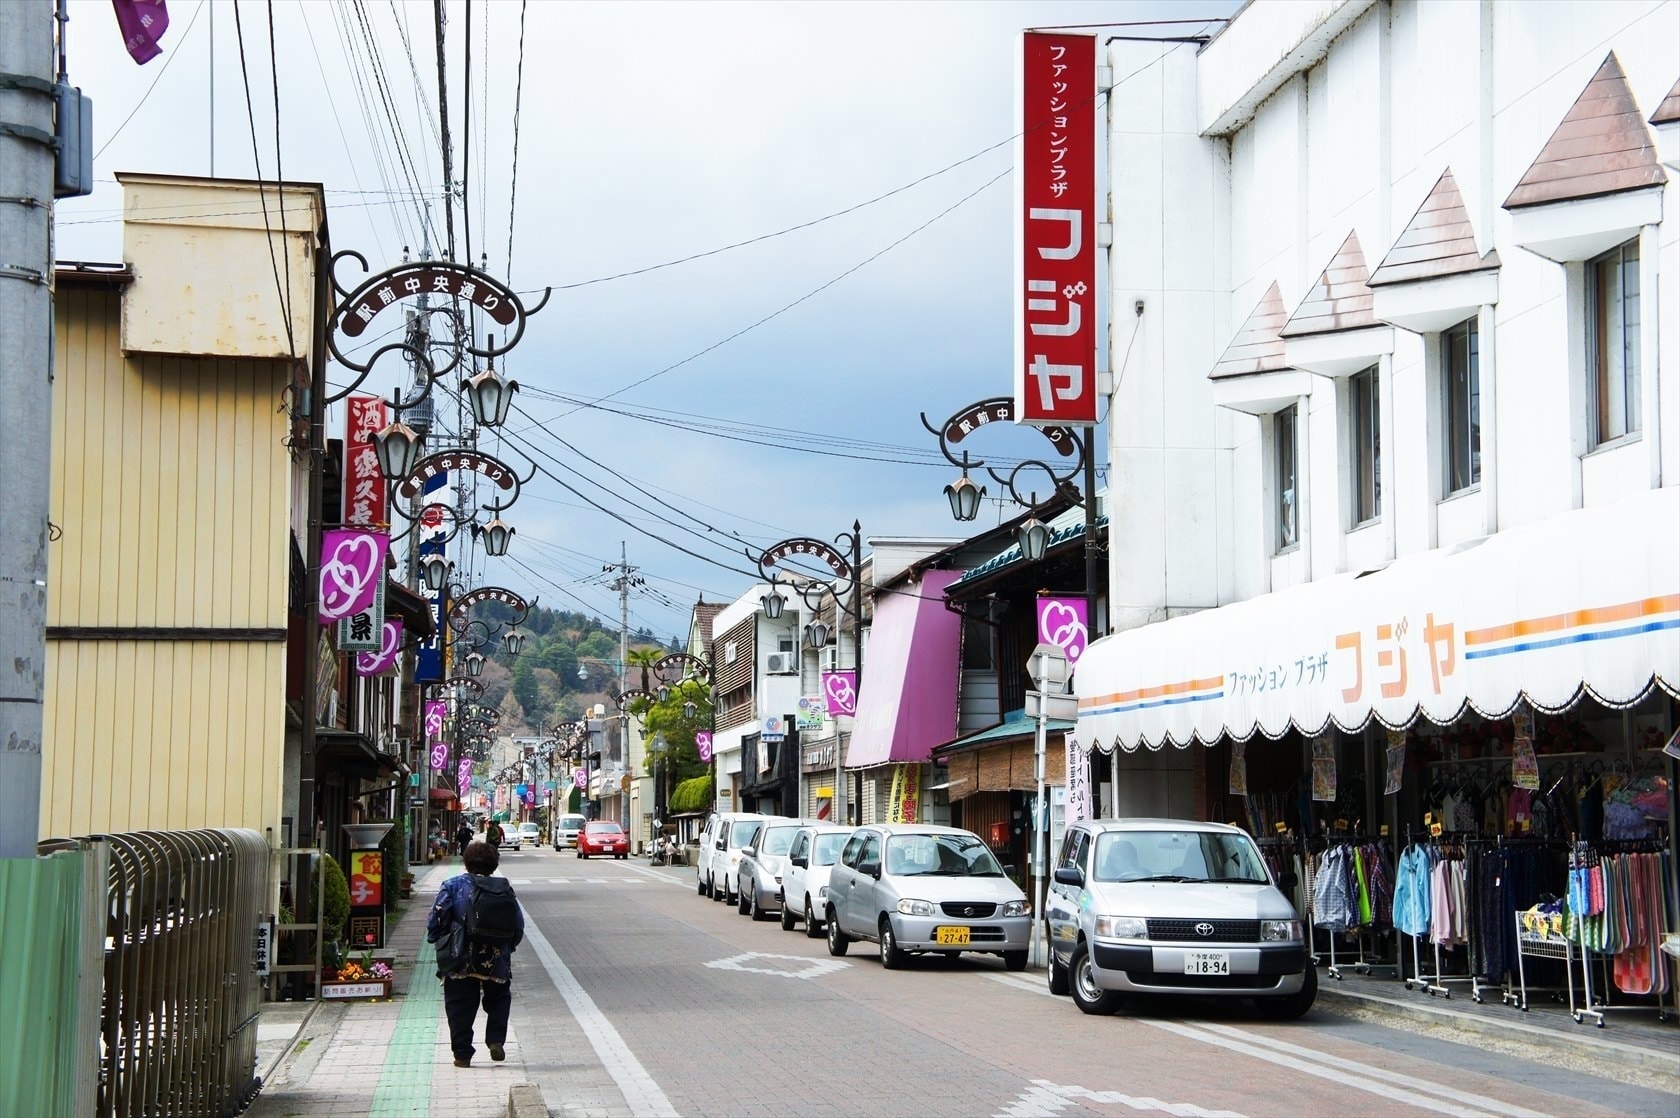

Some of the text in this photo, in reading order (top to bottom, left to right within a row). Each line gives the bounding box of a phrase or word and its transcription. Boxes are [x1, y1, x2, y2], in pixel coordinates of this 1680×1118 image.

[1050, 46, 1068, 198] ファッションプラザ
[356, 275, 499, 324] 駅前中央通り
[1028, 208, 1087, 411] フジヤ
[959, 407, 1063, 442] 駅前中り
[409, 458, 503, 489] 駅前中央通り
[1229, 664, 1288, 697] ファッション
[1335, 612, 1454, 704] フジヤ
[352, 853, 382, 904] 餃子
[257, 928, 267, 971] 本日休業
[944, 934, 968, 943] 27-47
[1196, 961, 1227, 973] 18-94
